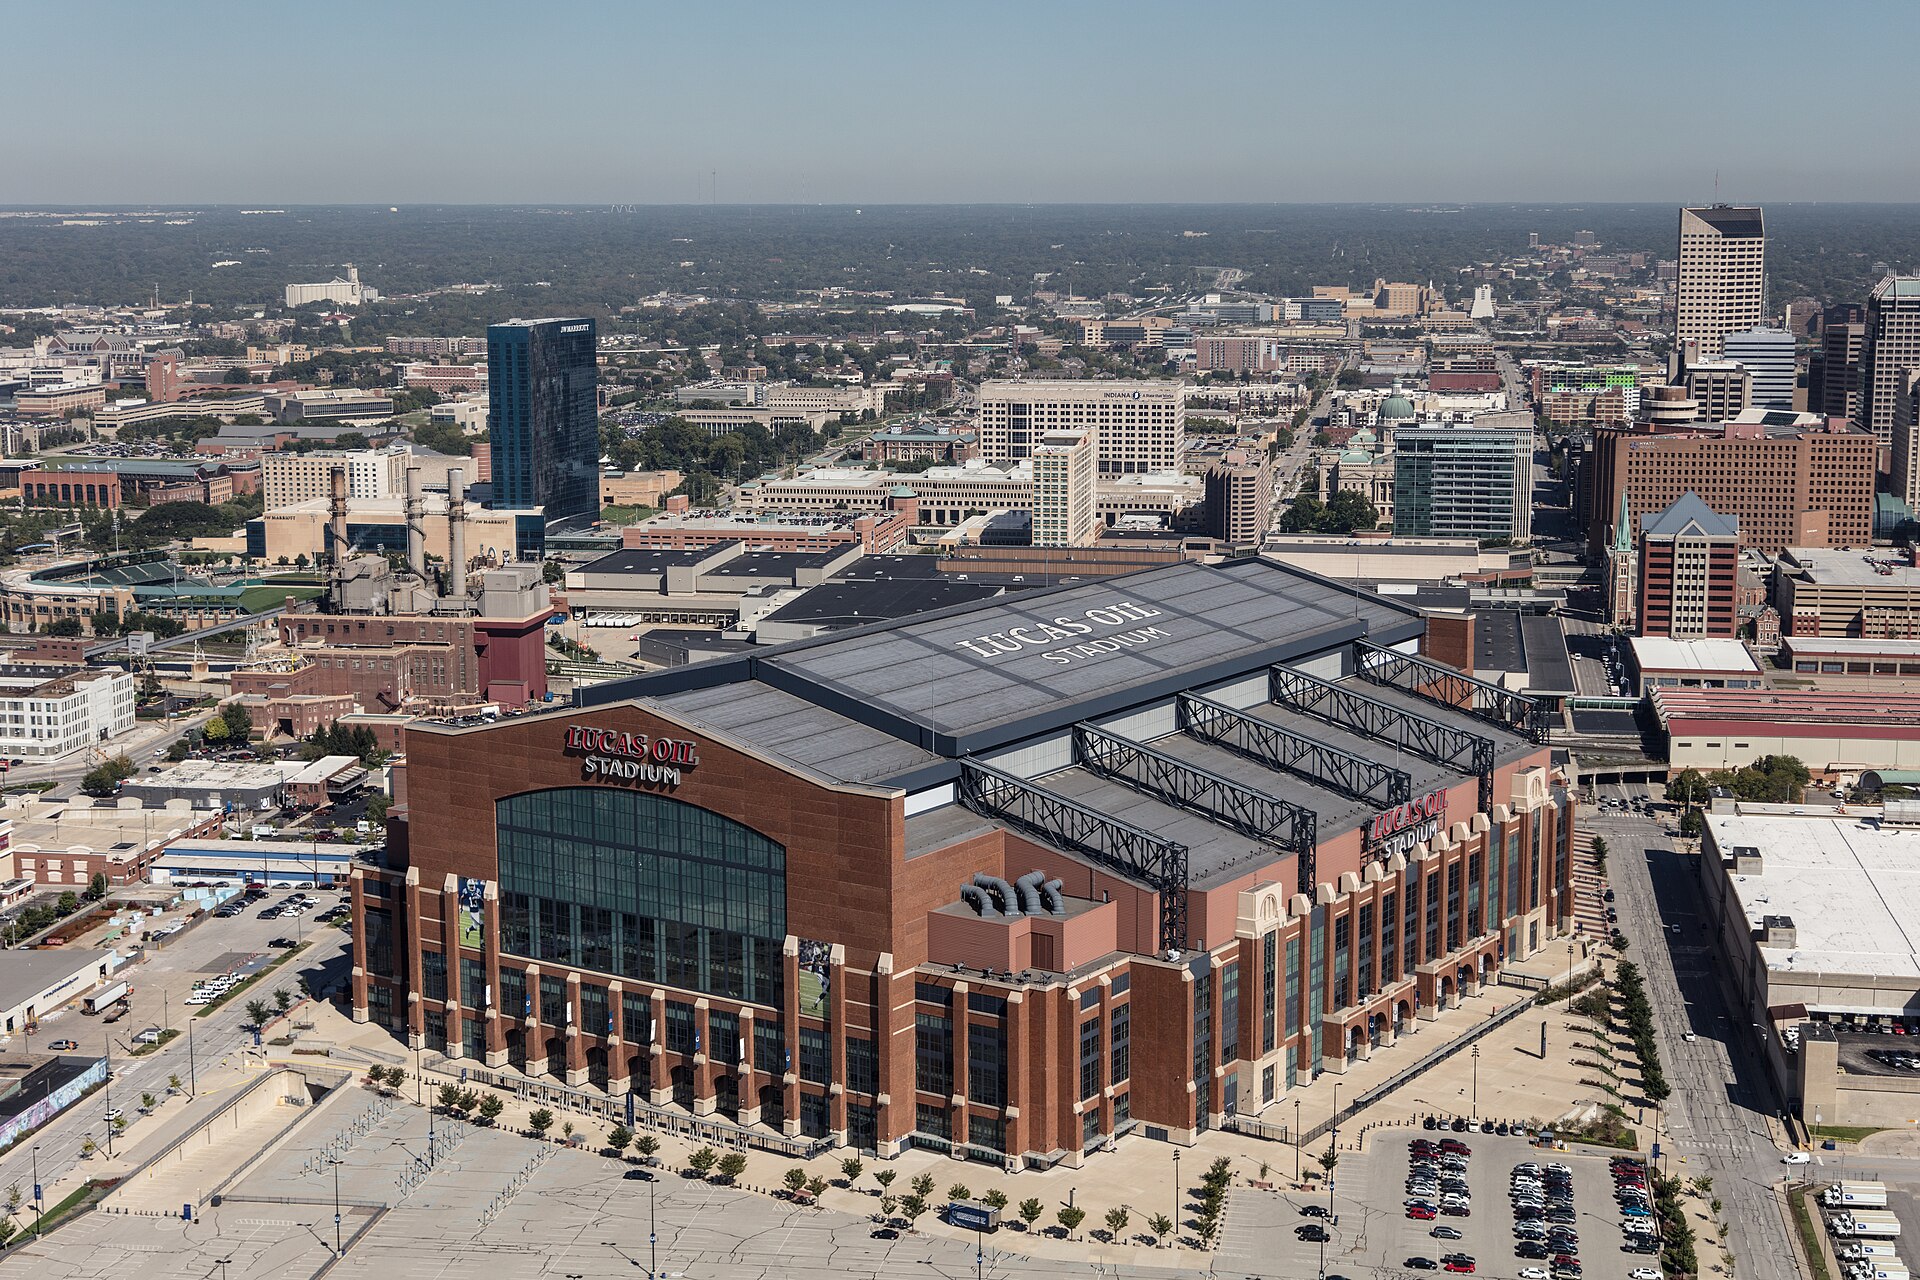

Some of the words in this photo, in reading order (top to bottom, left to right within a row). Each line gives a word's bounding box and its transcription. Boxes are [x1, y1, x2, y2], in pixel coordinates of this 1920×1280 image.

[955, 617, 1093, 658] LUCAS
[1084, 601, 1162, 626] OIL
[1041, 626, 1172, 664] STADIUM
[567, 725, 649, 758] LUCAS
[653, 737, 699, 765] OIL
[585, 755, 681, 785] STADIUM
[1371, 796, 1423, 839] LUCAS
[1424, 787, 1448, 817] OIL
[1383, 820, 1437, 859] STADIUM
